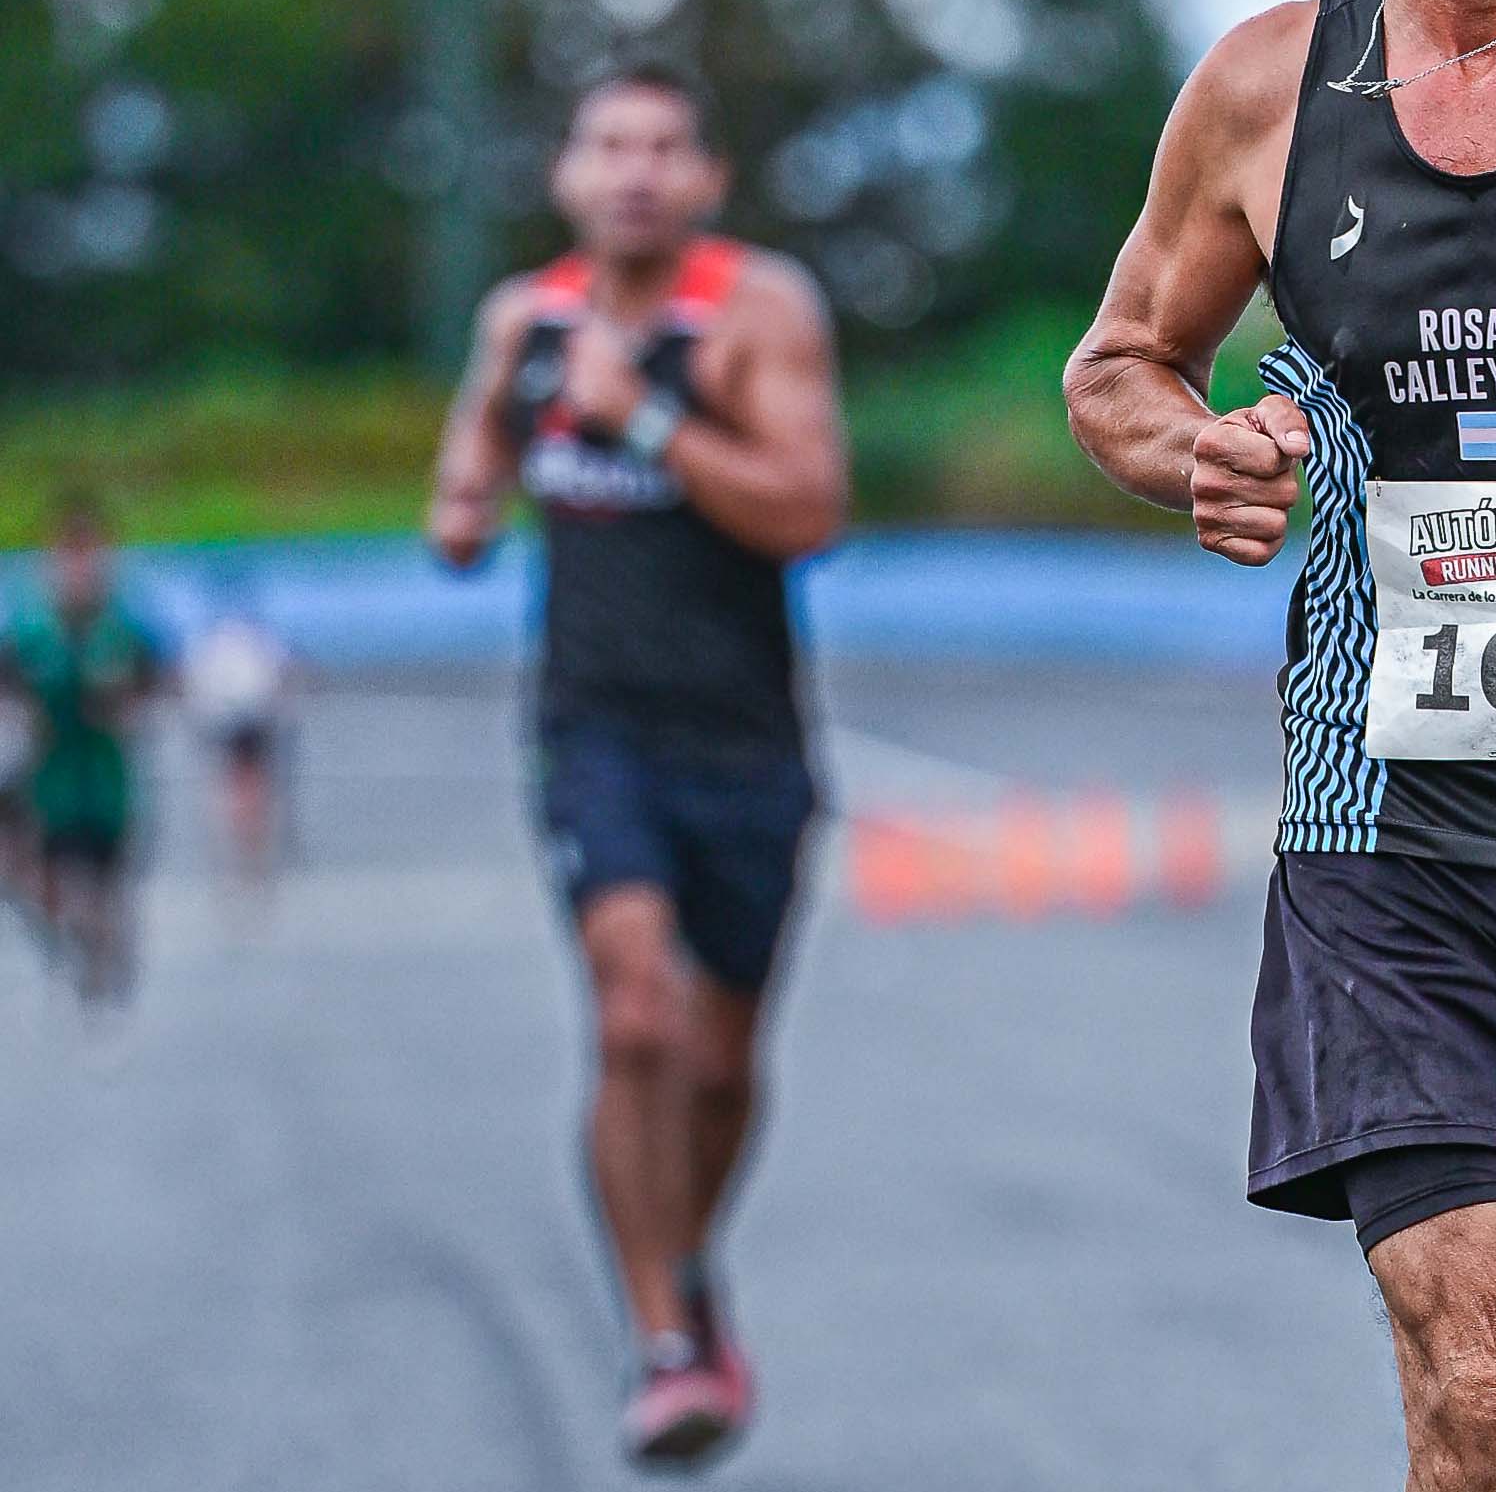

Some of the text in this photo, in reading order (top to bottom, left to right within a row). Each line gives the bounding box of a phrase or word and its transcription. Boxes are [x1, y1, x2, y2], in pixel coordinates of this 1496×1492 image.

[1412, 588, 1425, 600] La
[1427, 590, 1466, 602] Carrera
[1468, 590, 1483, 602] de
